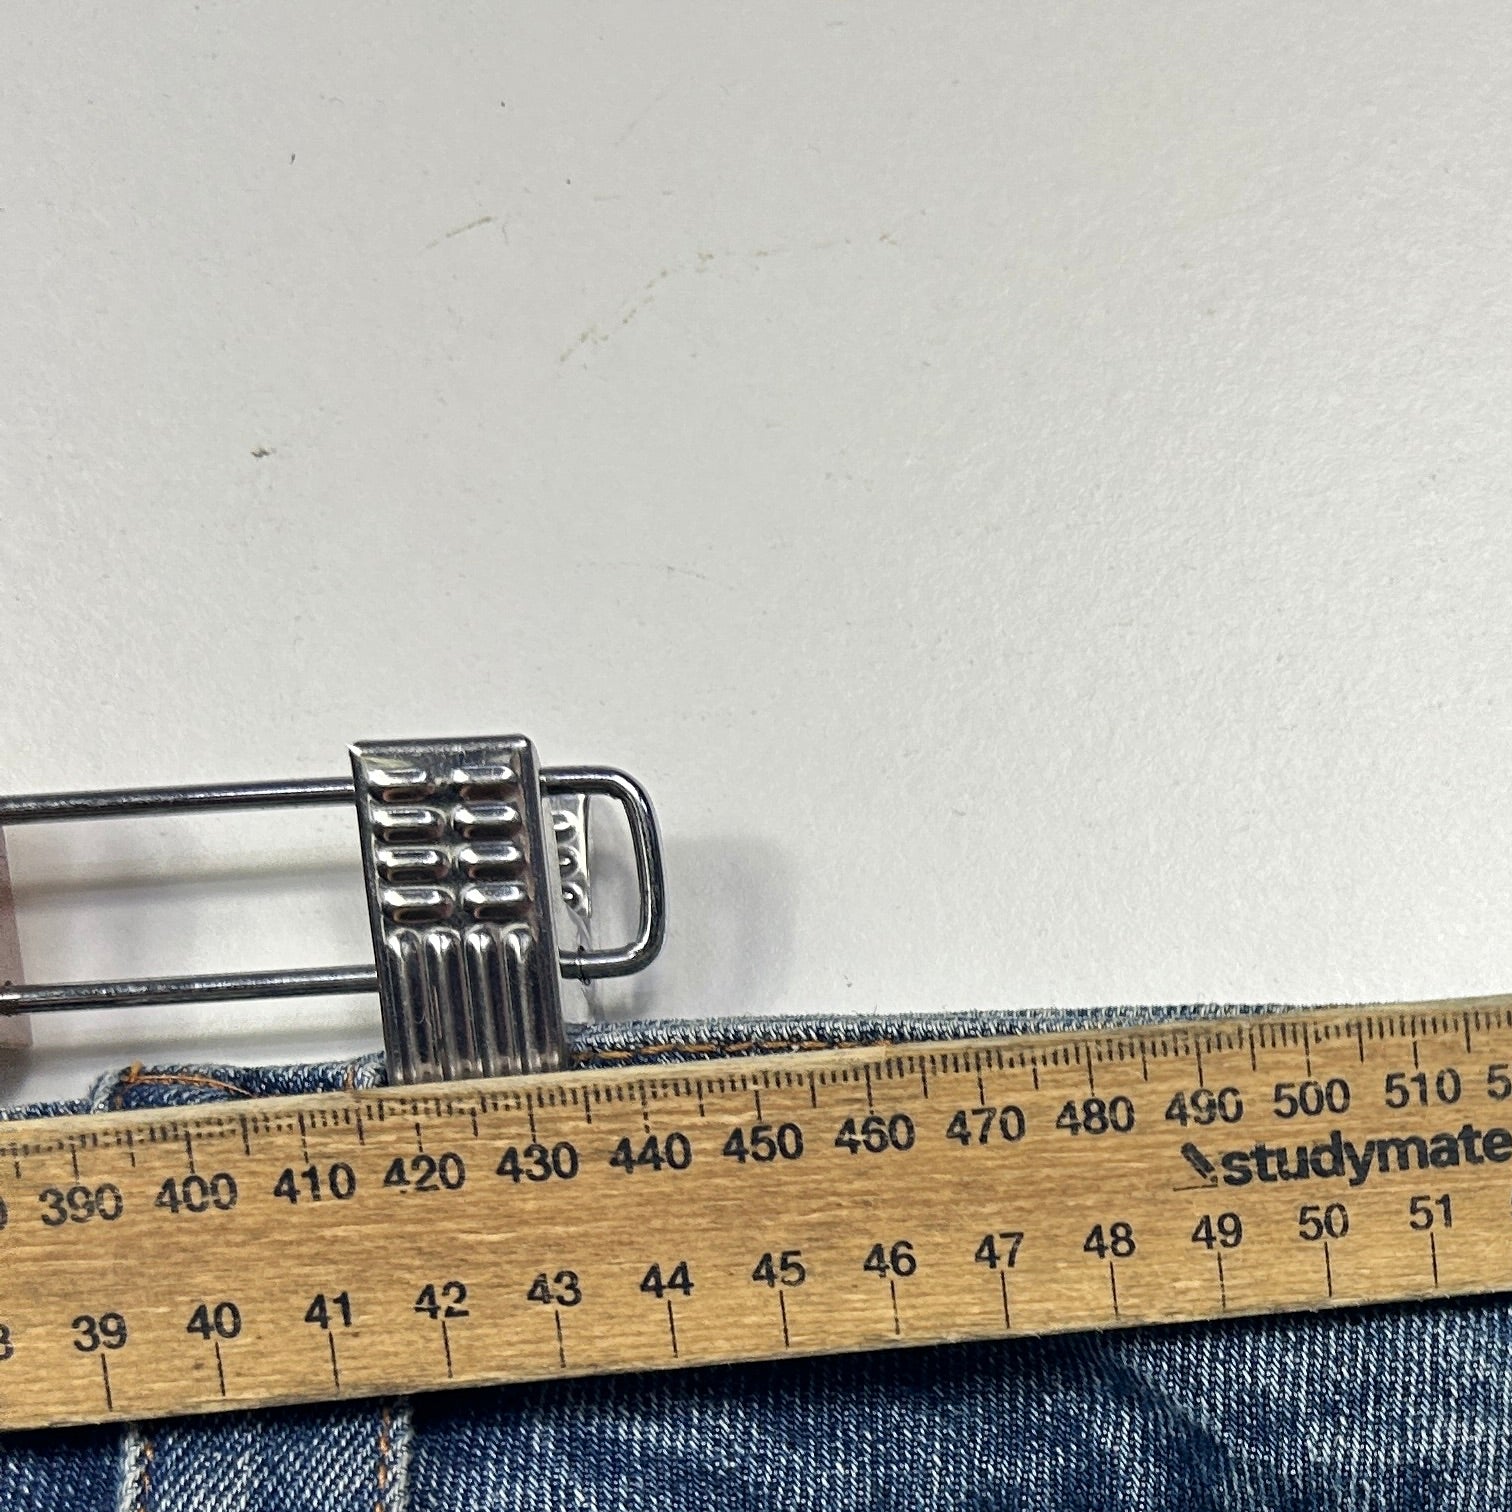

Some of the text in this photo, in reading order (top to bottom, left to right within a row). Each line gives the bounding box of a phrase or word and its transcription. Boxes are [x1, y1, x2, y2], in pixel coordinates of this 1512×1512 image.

[39, 1182, 123, 1227] 390
[154, 1172, 238, 1213] 400
[273, 1162, 356, 1204] 410
[383, 1153, 466, 1194] 420
[496, 1142, 579, 1183] 430
[609, 1132, 692, 1172] 440
[722, 1121, 803, 1163] 450
[835, 1112, 915, 1155] 460
[946, 1105, 1025, 1146] 470
[1055, 1096, 1134, 1136] 480
[1165, 1086, 1244, 1127] 490
[1273, 1077, 1351, 1119] 500
[1384, 1068, 1461, 1108] 510
[72, 1312, 128, 1353] 39
[187, 1302, 241, 1341] 40
[304, 1292, 354, 1330] 41
[415, 1281, 469, 1321] 42
[527, 1270, 582, 1308] 43
[640, 1261, 694, 1300] 44
[752, 1251, 806, 1291] 45
[863, 1240, 917, 1279] 46
[974, 1232, 1025, 1271] 47
[1083, 1222, 1136, 1259] 48
[1191, 1213, 1243, 1251] 49
[1298, 1203, 1349, 1242] 50
[1409, 1193, 1453, 1231] 51
